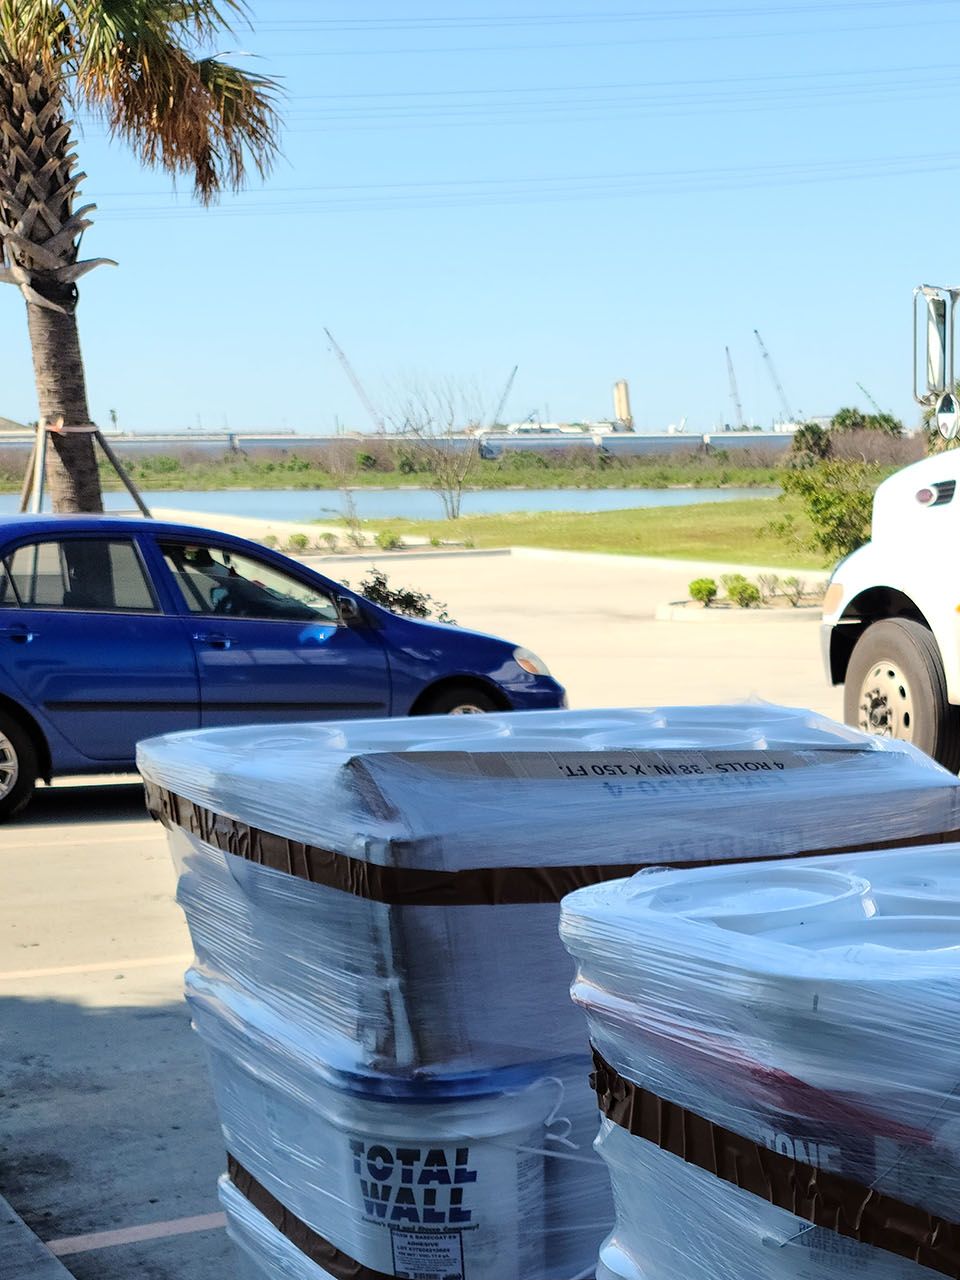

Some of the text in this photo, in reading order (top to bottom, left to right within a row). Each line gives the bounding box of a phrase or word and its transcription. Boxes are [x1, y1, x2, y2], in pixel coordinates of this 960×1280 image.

[557, 764, 589, 777] FT.
[590, 764, 626, 777] 150
[629, 764, 648, 776] X
[646, 763, 678, 776] IN.
[678, 763, 705, 775] 38
[714, 761, 771, 774] ROLLS
[350, 1140, 478, 1186] TOTAL
[361, 1180, 473, 1224] WALL
